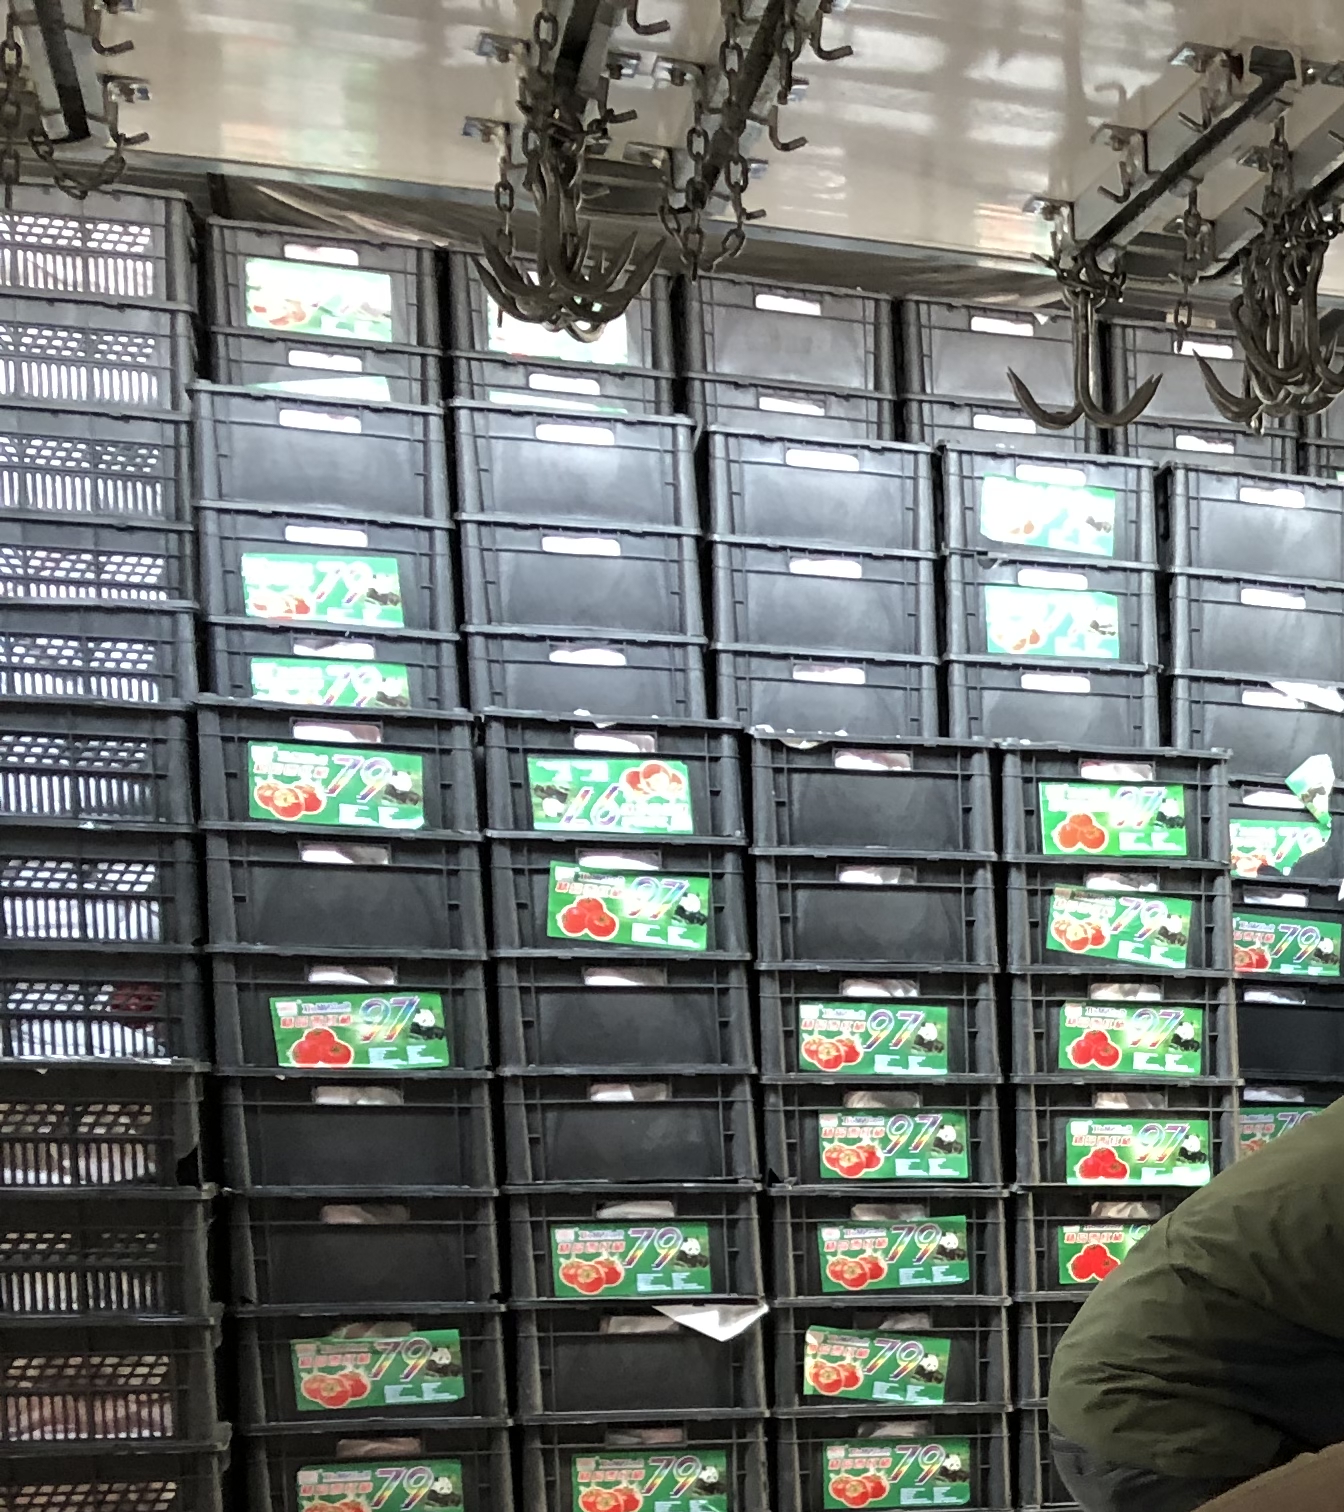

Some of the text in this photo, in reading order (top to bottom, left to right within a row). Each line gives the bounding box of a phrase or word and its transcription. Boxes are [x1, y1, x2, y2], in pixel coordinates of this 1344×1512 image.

[327, 755, 393, 802] 79
[628, 877, 689, 920] 97
[1110, 896, 1168, 940] 79
[1275, 923, 1321, 963] 79
[360, 996, 420, 1043] 97
[862, 1010, 926, 1052] 97
[1129, 1008, 1184, 1049] 97
[884, 1114, 943, 1156] 97
[1135, 1123, 1190, 1163] 97
[1277, 1112, 1318, 1137] 7
[623, 1227, 683, 1270] 79
[885, 1224, 942, 1263] 79
[371, 1338, 432, 1380] 79
[868, 1337, 923, 1380] 79
[643, 1456, 702, 1497] 79
[890, 1444, 946, 1485] 79
[373, 1466, 434, 1510] 79
